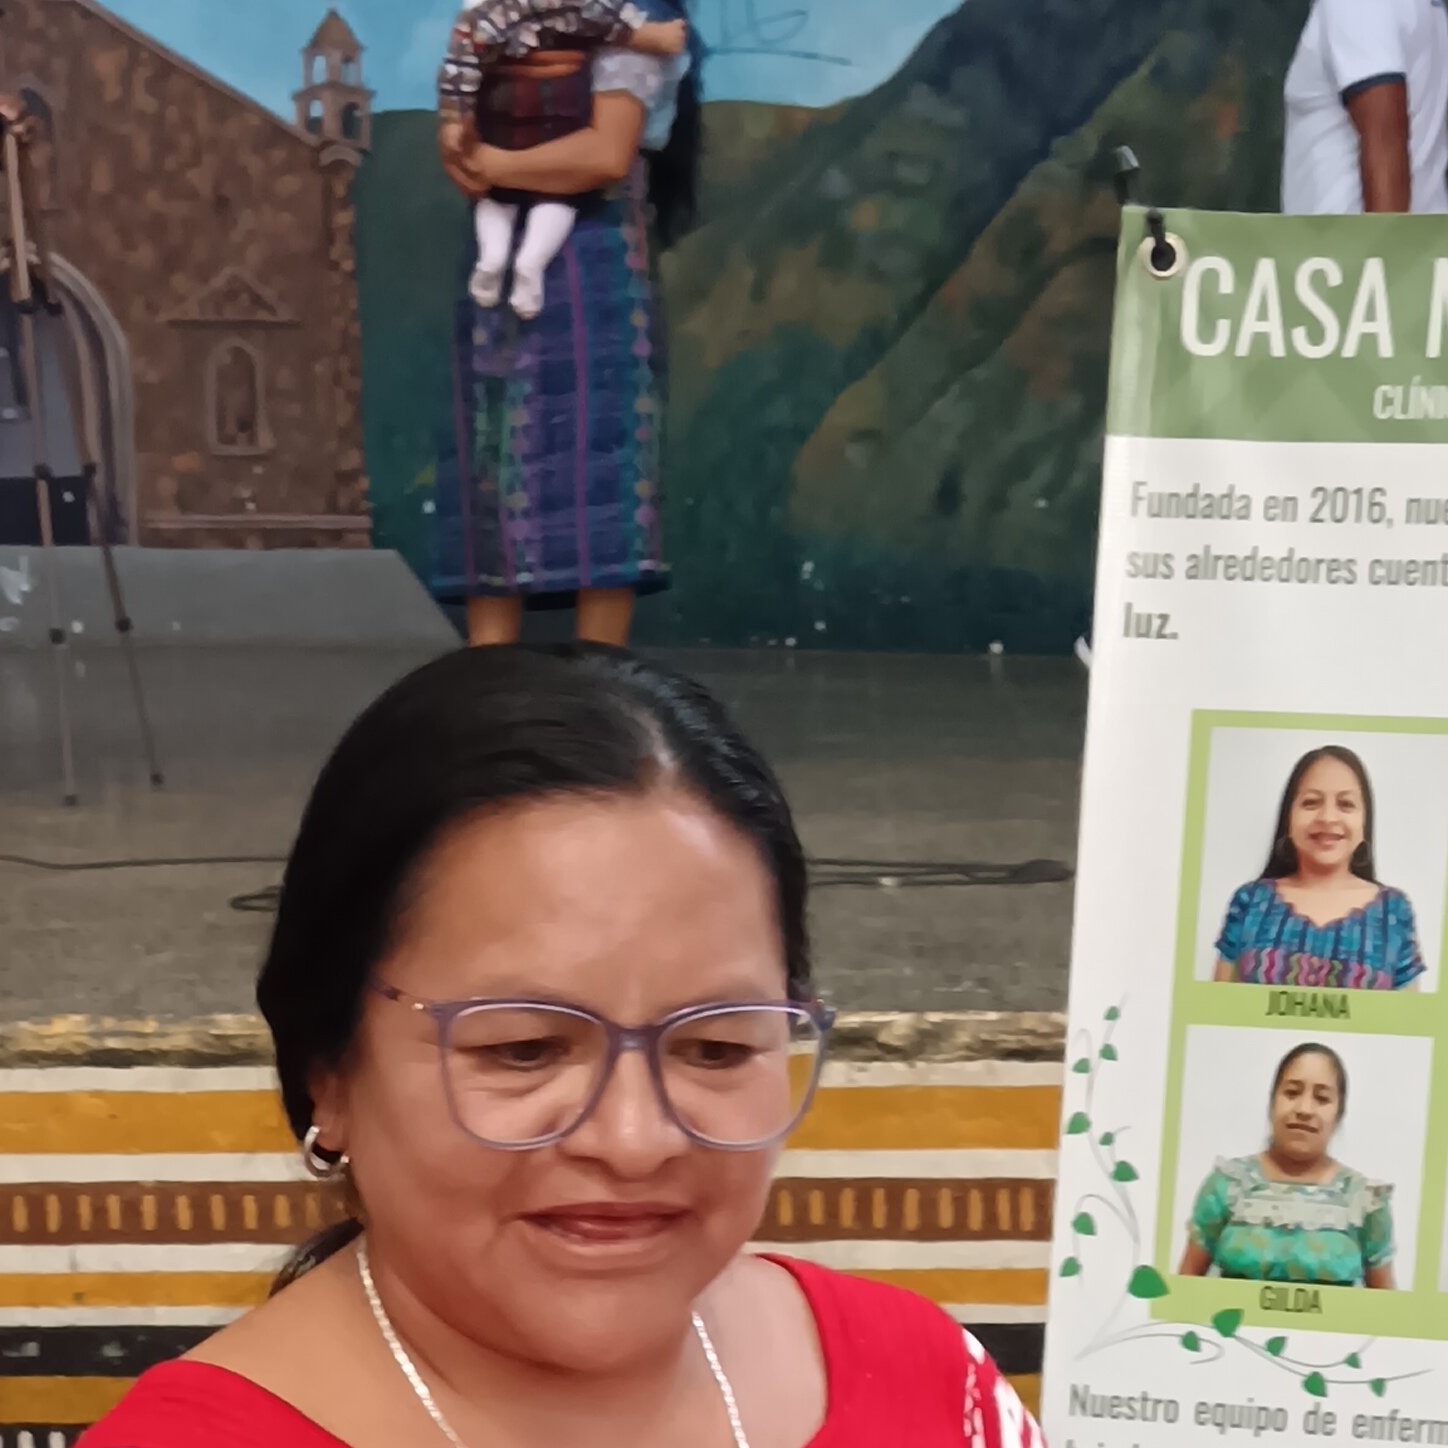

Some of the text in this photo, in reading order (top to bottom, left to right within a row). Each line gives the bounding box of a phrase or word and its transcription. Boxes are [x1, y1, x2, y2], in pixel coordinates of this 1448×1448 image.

[1179, 256, 1394, 358] CASA
[1131, 481, 1252, 521] Fundada
[1263, 491, 1298, 522] en
[1309, 483, 1394, 529] 2016,
[1125, 552, 1173, 582] sus
[1184, 544, 1356, 584] alrededores
[1122, 602, 1179, 640] luz.
[1265, 991, 1351, 1020] JOHANA
[1259, 1284, 1322, 1316] GILDA
[1069, 1383, 1179, 1426] Nuestro
[1194, 1397, 1288, 1441] equipo
[1303, 1402, 1336, 1439] de
